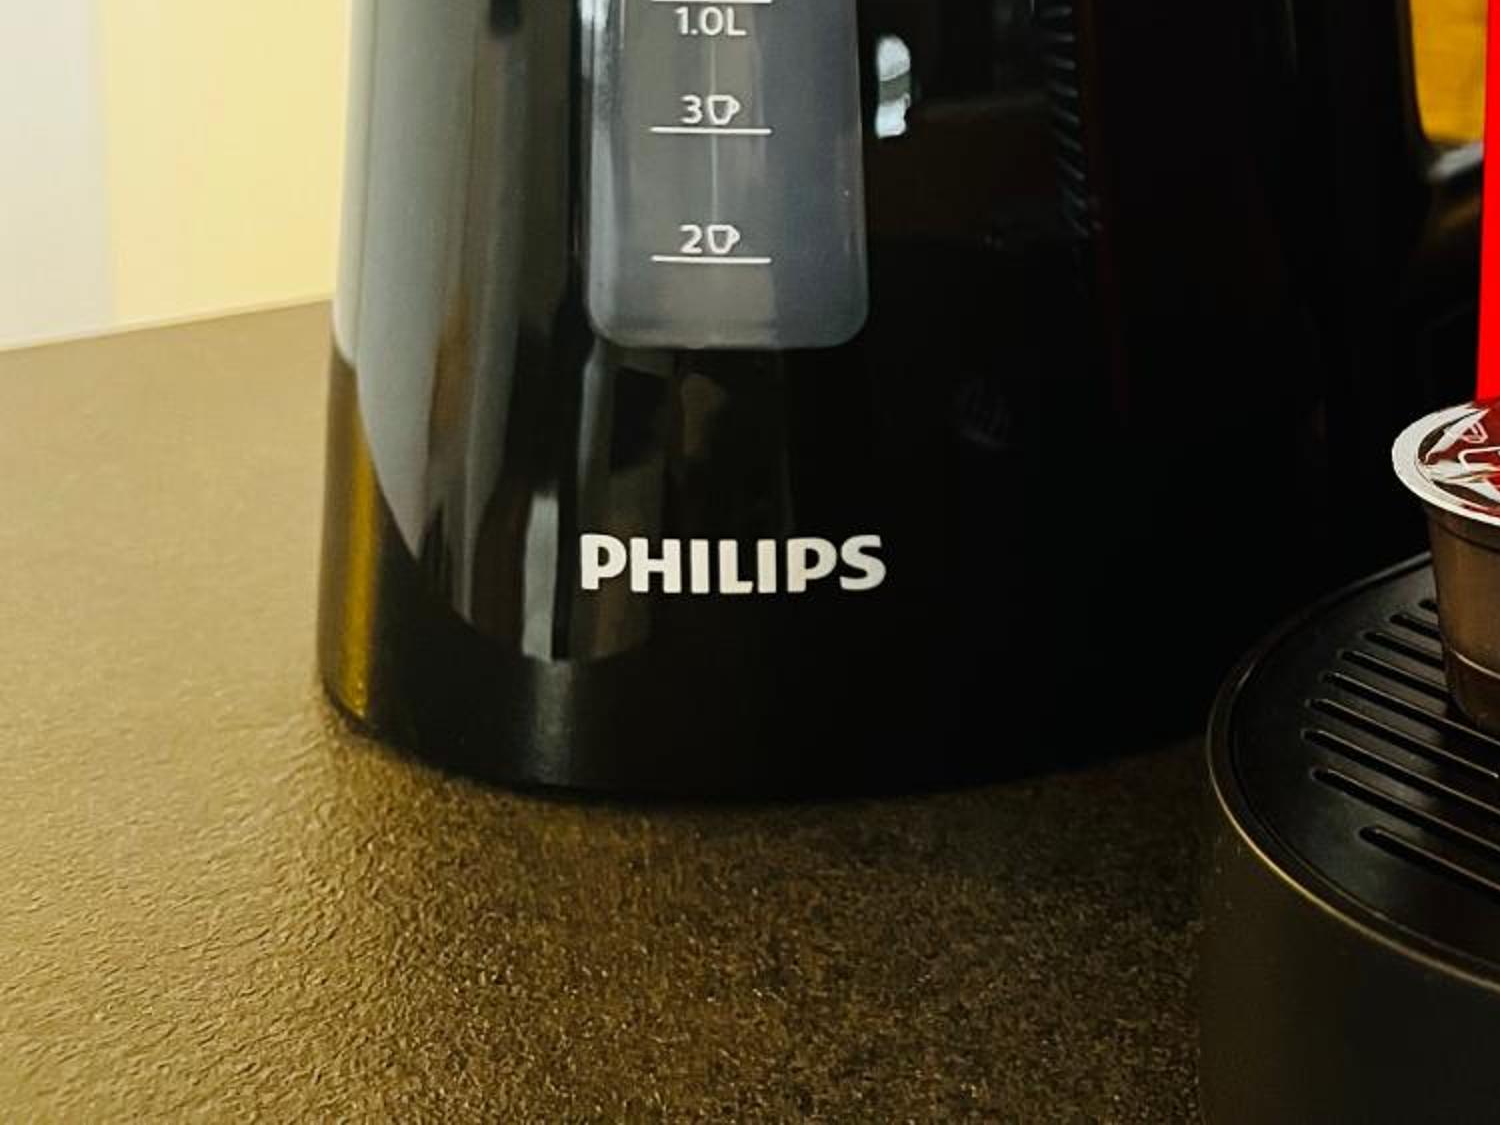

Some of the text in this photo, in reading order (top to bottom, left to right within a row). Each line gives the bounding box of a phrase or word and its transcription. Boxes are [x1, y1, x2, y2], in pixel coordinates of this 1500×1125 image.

[675, 6, 747, 36] 1.0L
[682, 95, 703, 125] 3
[680, 224, 703, 254] 2
[580, 533, 887, 594] PHILIPS
